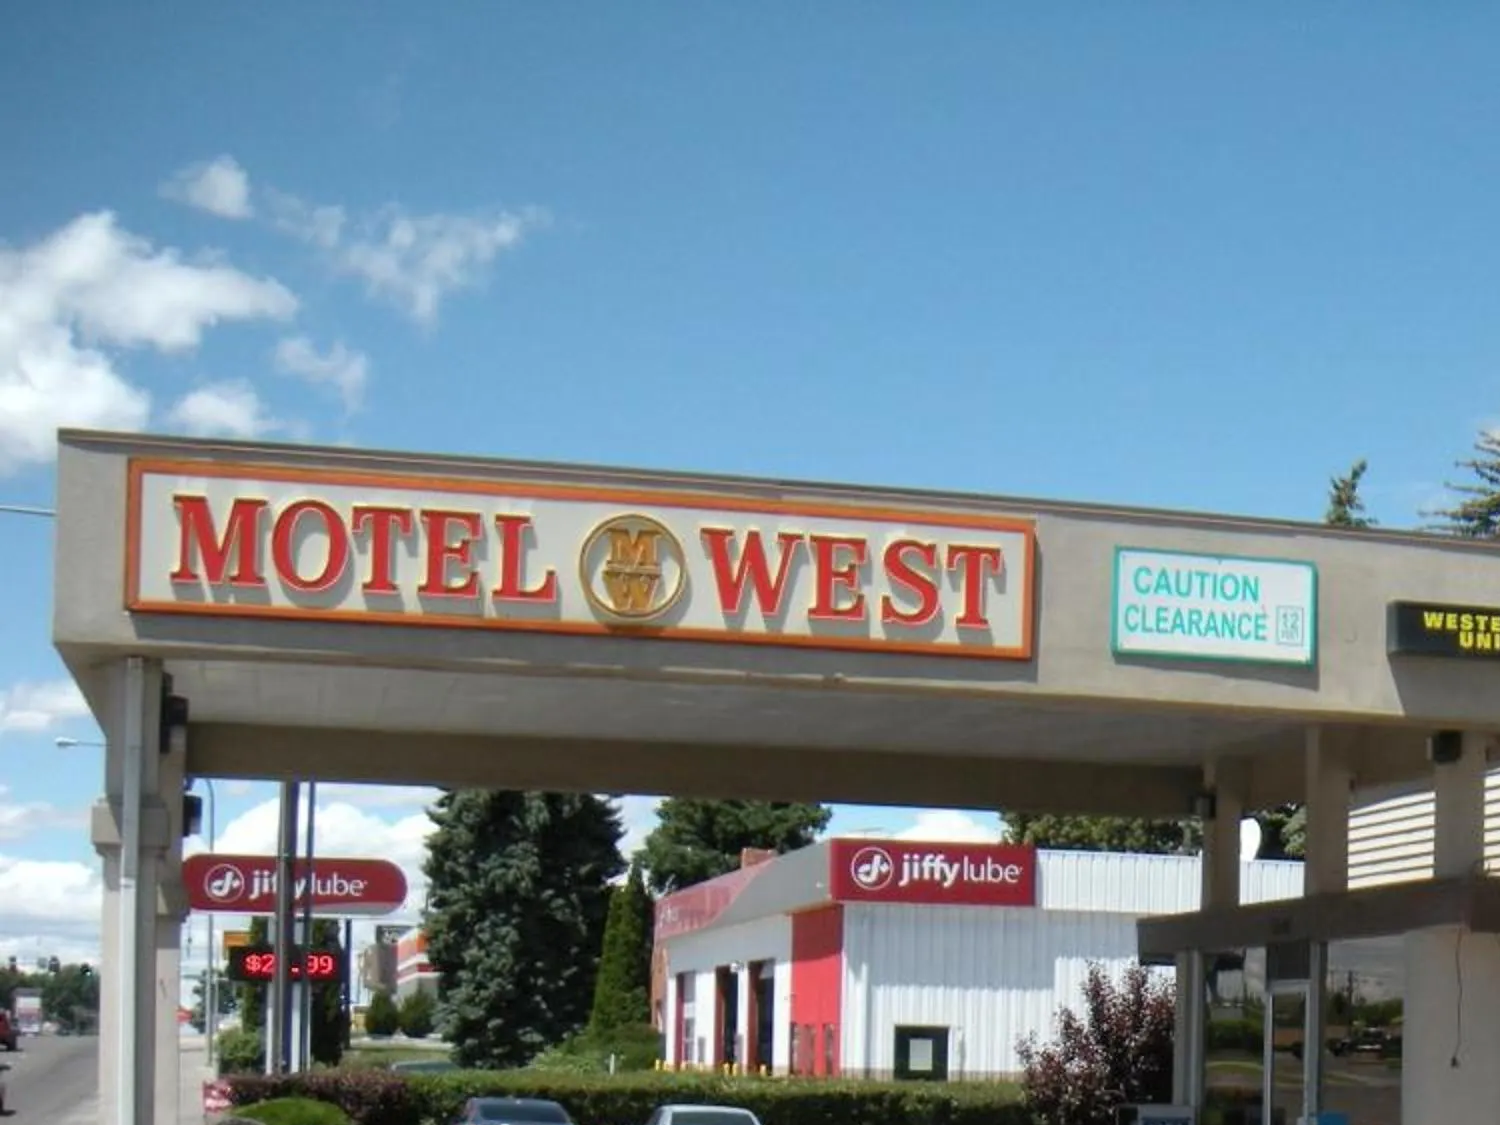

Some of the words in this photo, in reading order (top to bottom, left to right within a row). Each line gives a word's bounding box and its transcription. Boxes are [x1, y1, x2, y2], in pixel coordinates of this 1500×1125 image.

[171, 494, 556, 592] MOTEL
[606, 526, 664, 566] M
[602, 570, 660, 611] W
[700, 527, 1001, 629] WEST
[1133, 565, 1260, 604] CAUTION
[1124, 604, 1268, 641] CLEARANCE
[249, 870, 305, 900] jify
[311, 872, 364, 897] lube
[898, 853, 960, 887] jiffy
[963, 856, 1020, 884] lube
